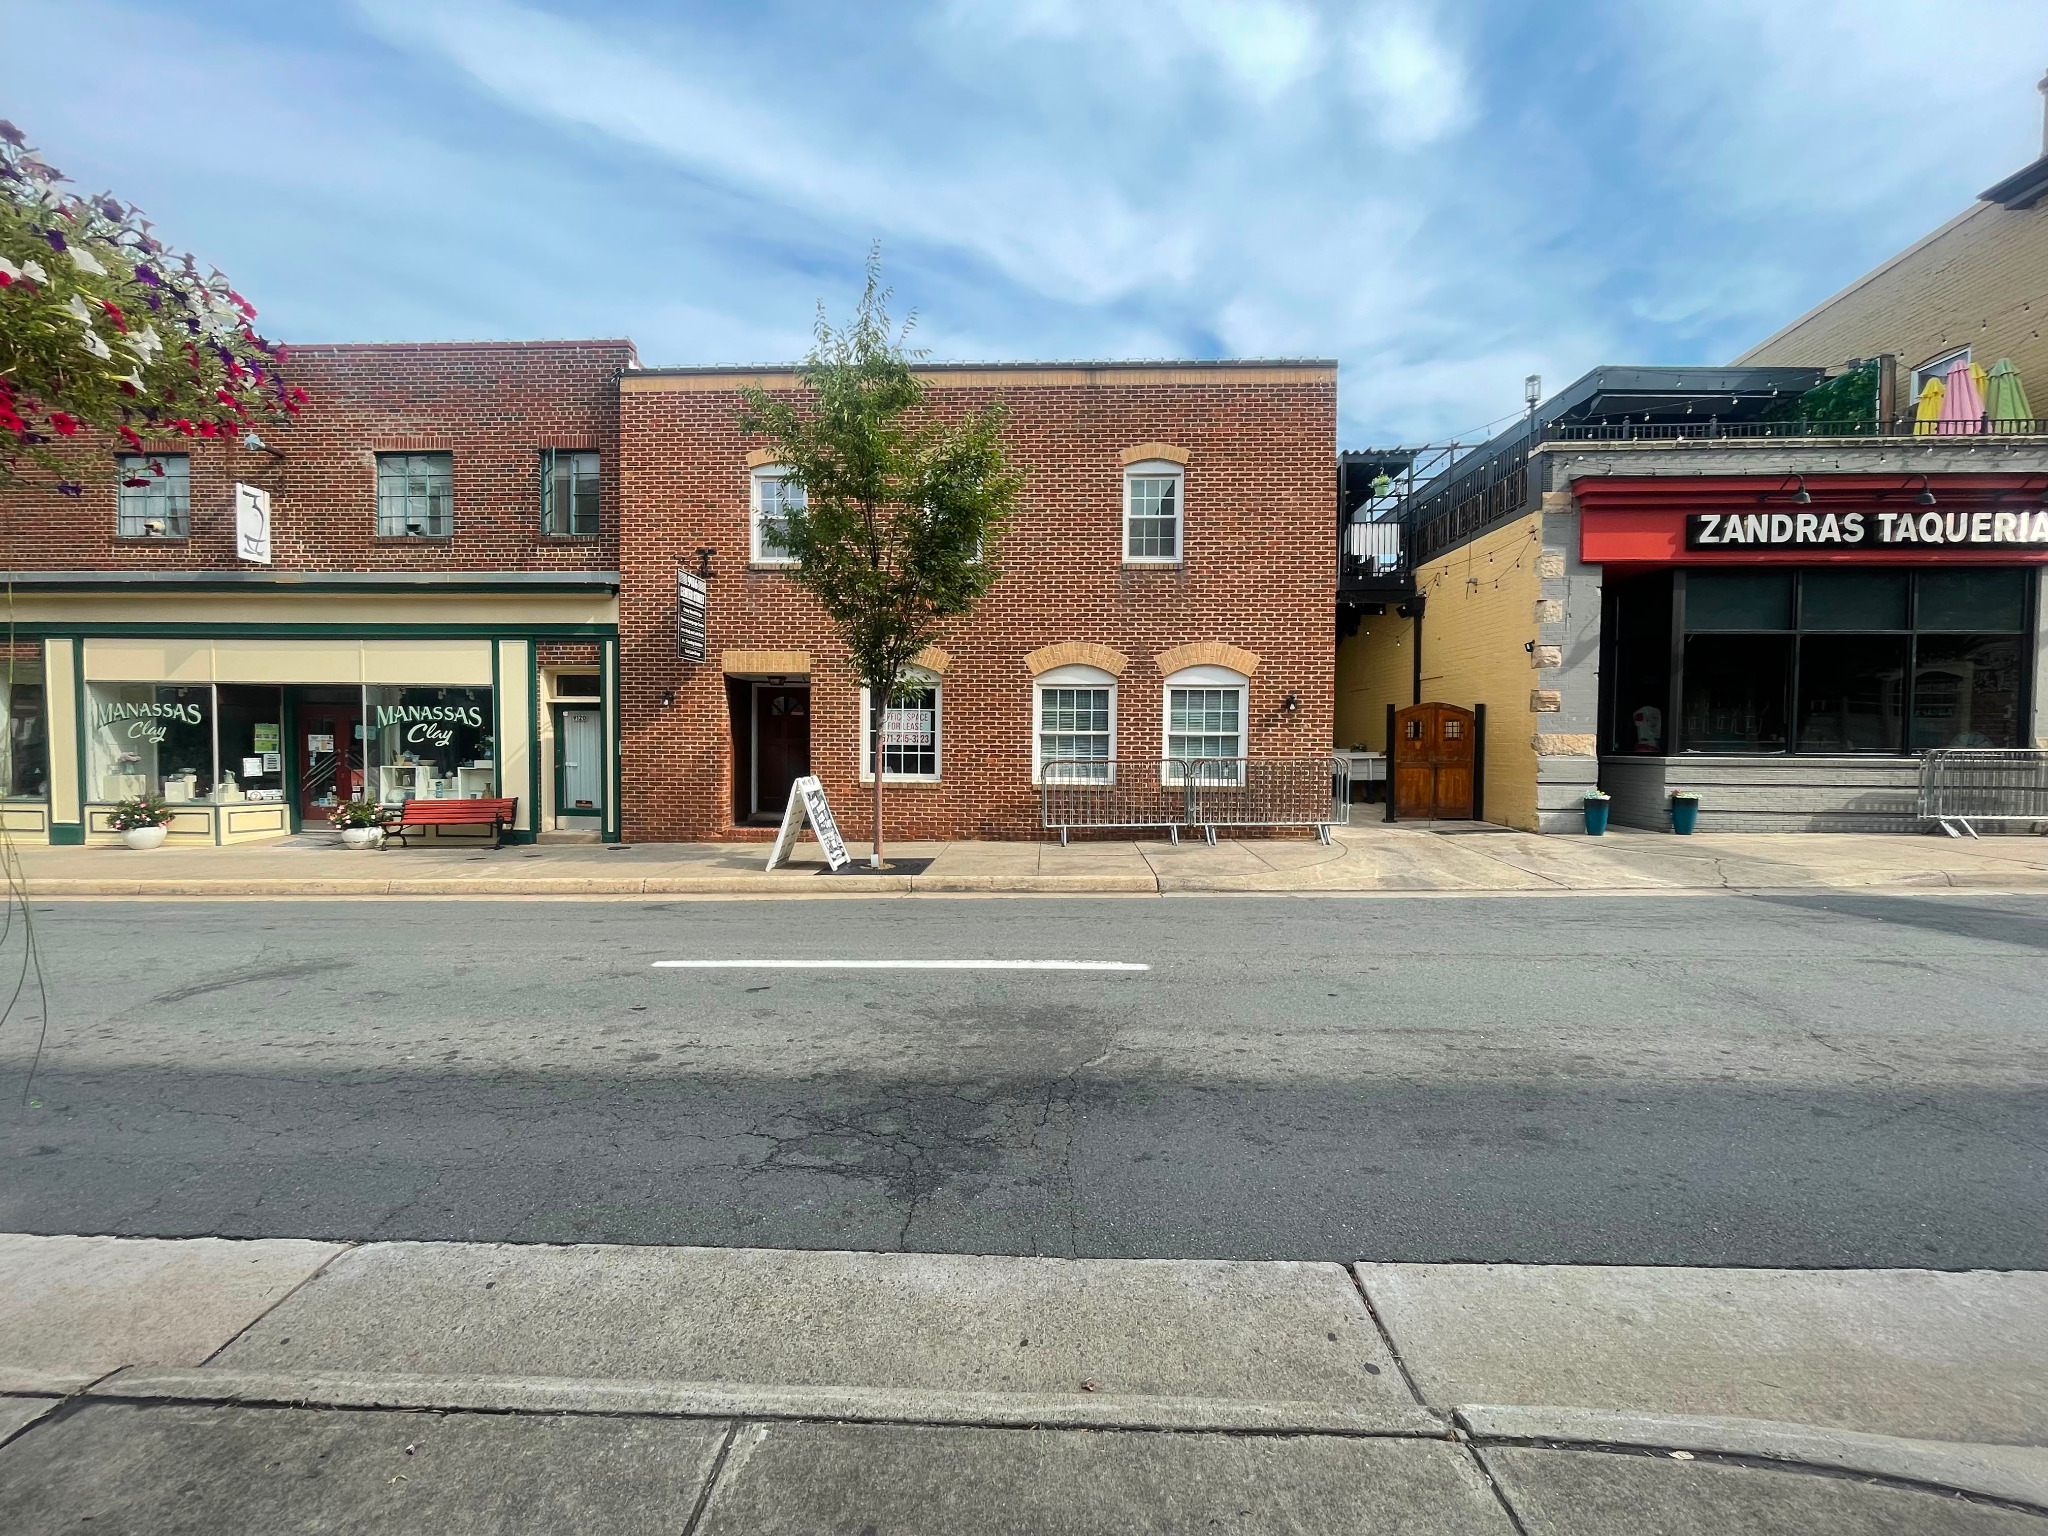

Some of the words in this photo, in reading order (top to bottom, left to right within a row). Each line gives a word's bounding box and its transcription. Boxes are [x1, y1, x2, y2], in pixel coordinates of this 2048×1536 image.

[1699, 512, 1865, 543] ZANDRAS
[1878, 511, 2048, 544] TAQUERIA
[97, 702, 202, 729] MANASSAS
[376, 705, 482, 729] MANASSAS
[887, 722, 901, 731] FOR
[902, 722, 923, 731] LEASE
[906, 712, 928, 722] SPACE
[127, 720, 168, 744] Clay
[407, 722, 454, 747] Clay
